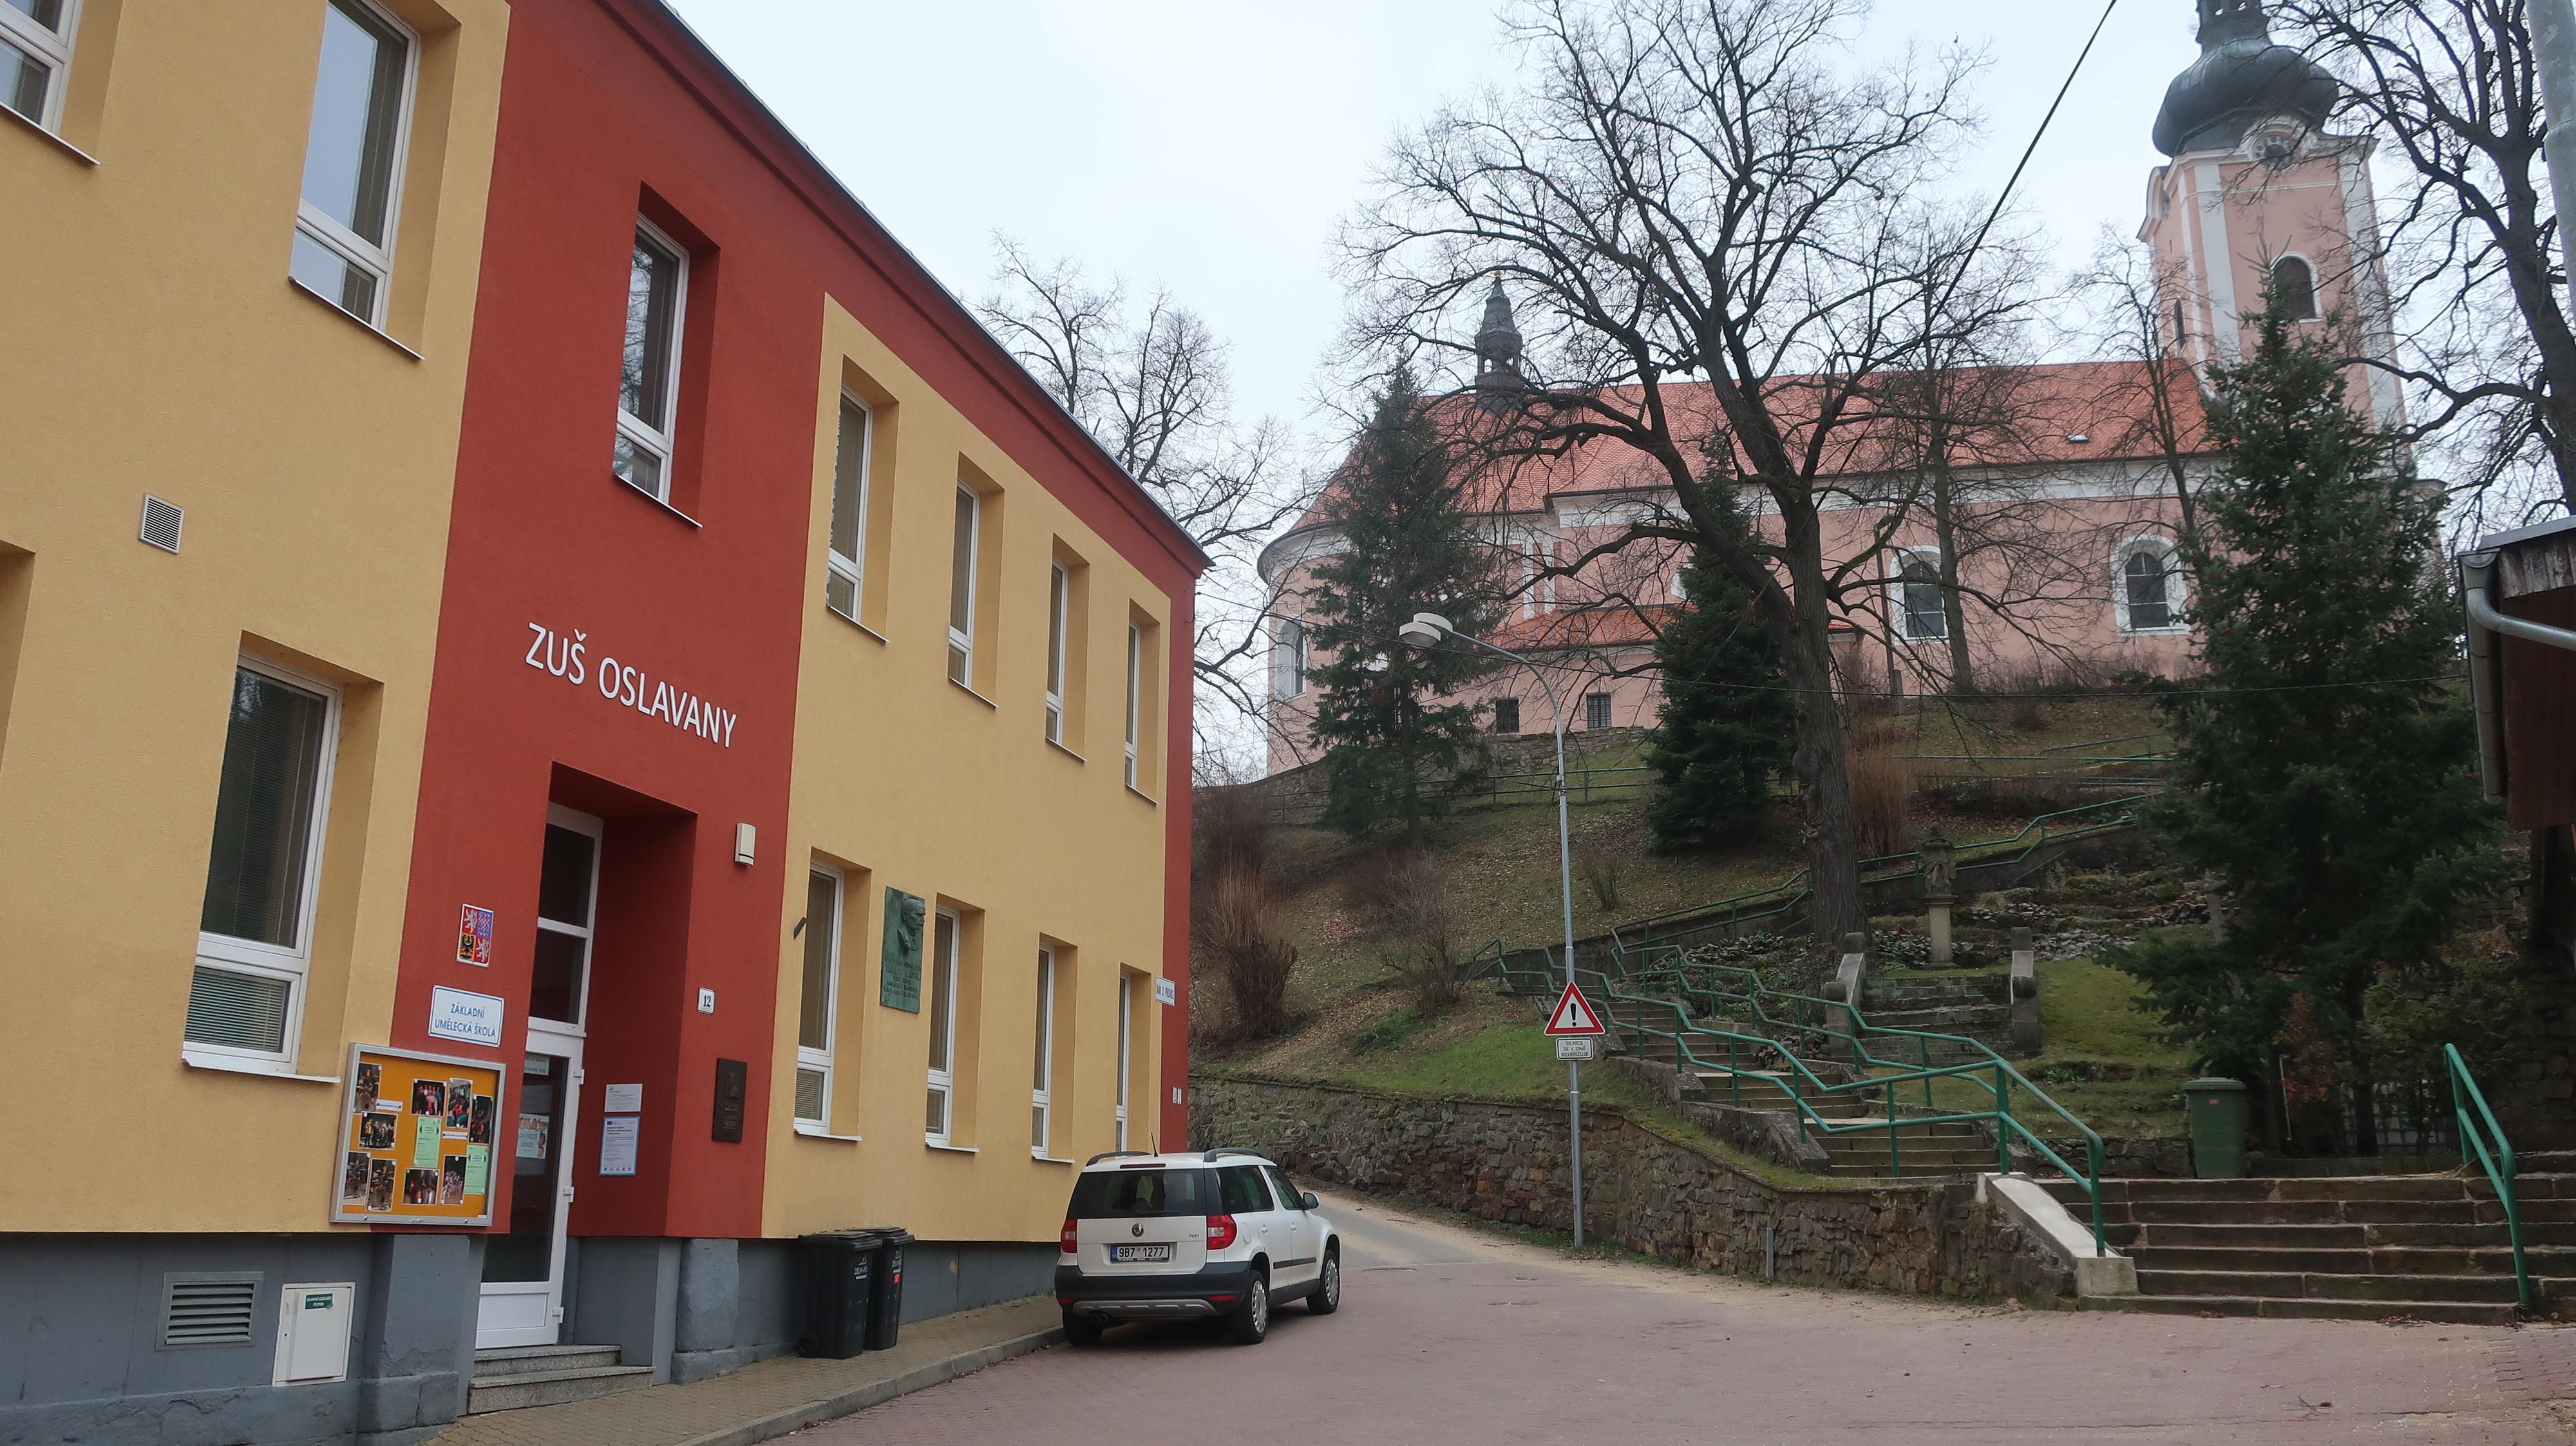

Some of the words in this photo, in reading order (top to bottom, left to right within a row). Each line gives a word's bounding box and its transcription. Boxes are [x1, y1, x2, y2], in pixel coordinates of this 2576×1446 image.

[525, 622, 587, 685] ZUŠ
[598, 656, 737, 748] OSLAVANY
[703, 994, 711, 1008] 12
[451, 1002, 486, 1018] ZÁKLADNÍ
[435, 1018, 472, 1033] UMĚLECKÁ
[474, 1023, 496, 1038] ŠKOLA
[1119, 1247, 1135, 1257] 9B7
[1142, 1247, 1164, 1257] 1277
